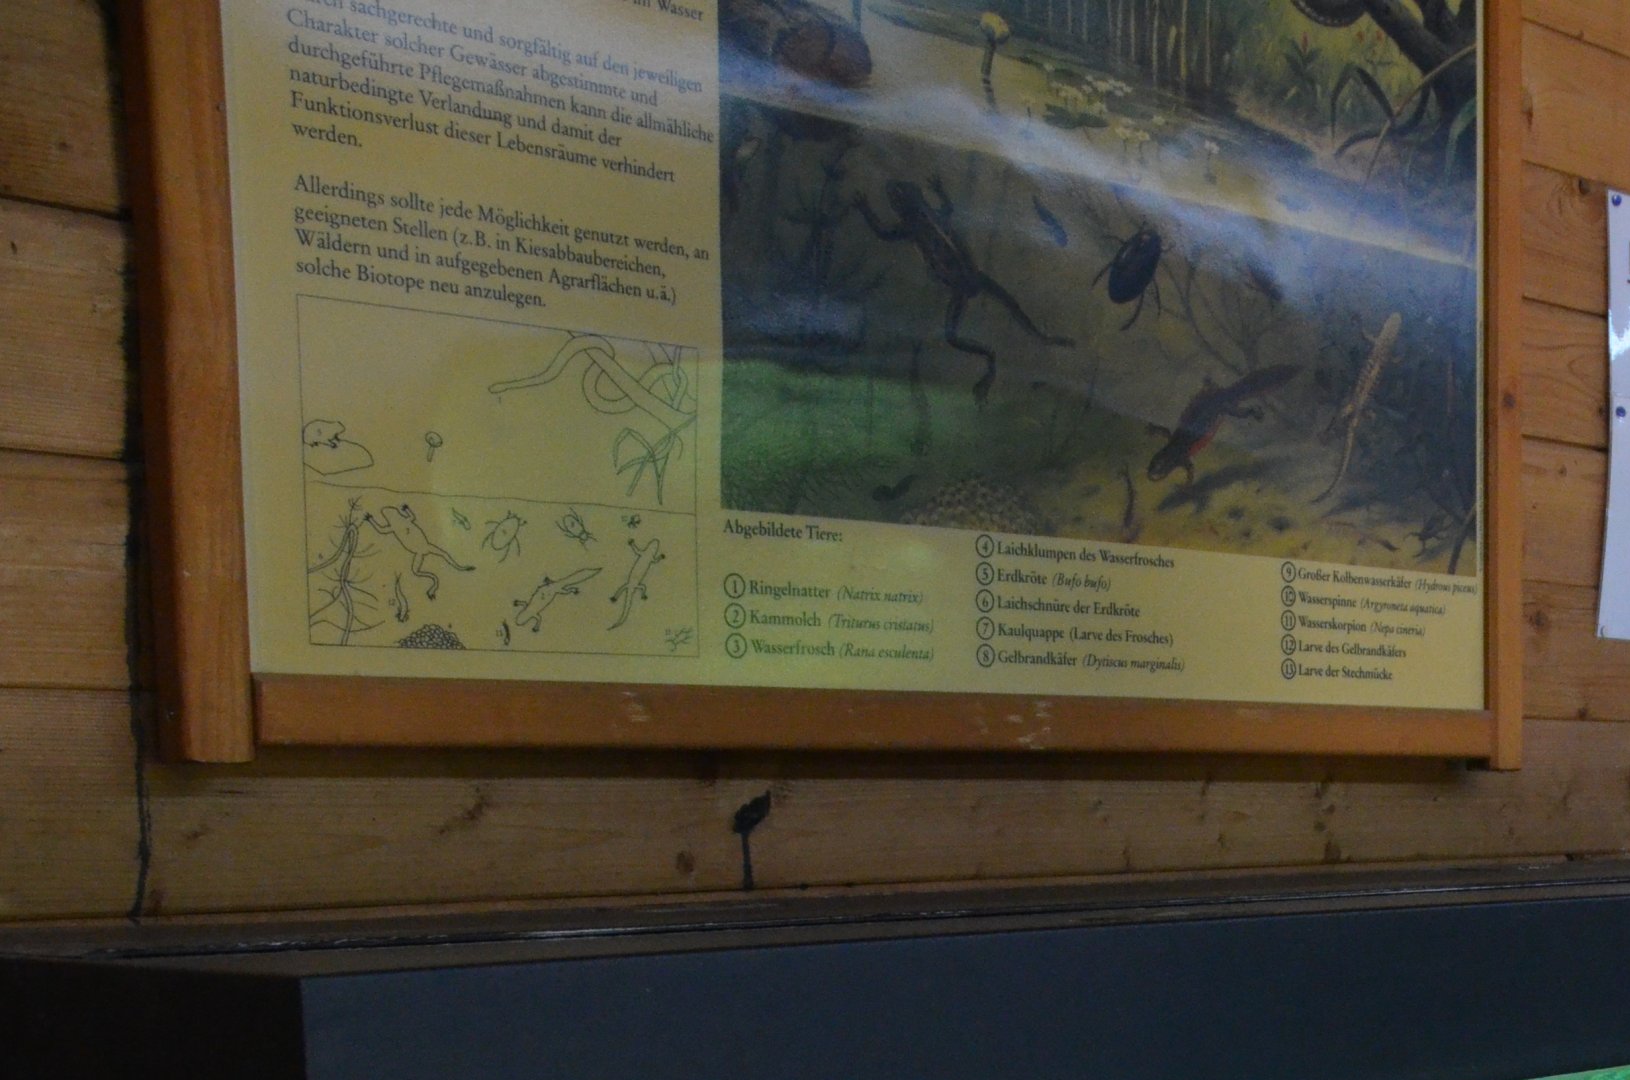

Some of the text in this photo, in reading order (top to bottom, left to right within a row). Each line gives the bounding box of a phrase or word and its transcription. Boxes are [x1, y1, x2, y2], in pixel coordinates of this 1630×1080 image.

[287, 8, 658, 107] Charakter solcher Gewässer abgestimmte und
[350, 0, 702, 94] sachgerechte und sorgfältig auf den jeweiligen
[288, 35, 714, 143] durchgeführte Pflegemaßnahmen kann die allmähliche
[290, 69, 622, 147] naturbedingte Verlandung und damit der
[290, 90, 676, 182] Funktionsverlust dieser Lebensräume verhindert
[291, 123, 363, 148] werden.
[294, 174, 709, 261] Allerdings sollte jede Möglichkeit genutzt werden, an
[294, 205, 387, 232] geeigneten
[393, 217, 447, 241] Stellen
[496, 233, 510, 252] in
[516, 236, 666, 279] Kiesabbaubereichen,
[294, 228, 371, 255] Wäldern
[377, 245, 409, 261] und
[415, 246, 431, 265] in
[435, 252, 543, 283] aufgegebenen
[549, 268, 642, 298] Agrarflächen
[296, 257, 546, 309] solche Biotope neu anzulegen.
[723, 518, 843, 542] Abgebildete Tiere:
[997, 541, 1077, 564] Laichklumpen
[1079, 548, 1096, 562] des
[1100, 550, 1175, 568] Wasserfrosches
[997, 568, 1048, 585] Erdkröte
[1052, 572, 1082, 590] (Bufo
[1084, 575, 1112, 592] bufo)
[1298, 566, 1331, 583] Großer
[1333, 570, 1412, 588] Kolbenwasserkäfer
[749, 580, 831, 600] Ringelnatter
[837, 585, 881, 602] (Natrix
[884, 587, 924, 606] natrix)
[1298, 591, 1357, 610] Wasserspinne
[997, 596, 1070, 613] Laichschnüre
[1073, 600, 1091, 614] der
[1094, 602, 1141, 618] Erdkröte
[750, 609, 821, 627] Kammolch
[828, 613, 881, 630] (Triturus
[883, 617, 935, 635] cristatus)
[998, 622, 1065, 643] Kaulquappe
[1069, 626, 1103, 642] (Larve
[1105, 628, 1123, 642] des
[1125, 630, 1174, 647] Frosches)
[1298, 615, 1366, 634] Wasserskorpion
[751, 638, 835, 657] Wasserfrosch
[838, 643, 875, 661] (Rana
[878, 645, 935, 662] esculenta)
[998, 650, 1078, 667] Gelbrandkäfer
[1298, 639, 1323, 653] Larve
[1325, 641, 1340, 655] des
[1342, 642, 1407, 659] Gelbrandkäfers
[1298, 663, 1323, 677] Larve
[1325, 665, 1340, 678] der
[1342, 665, 1392, 680] Stechmücke
